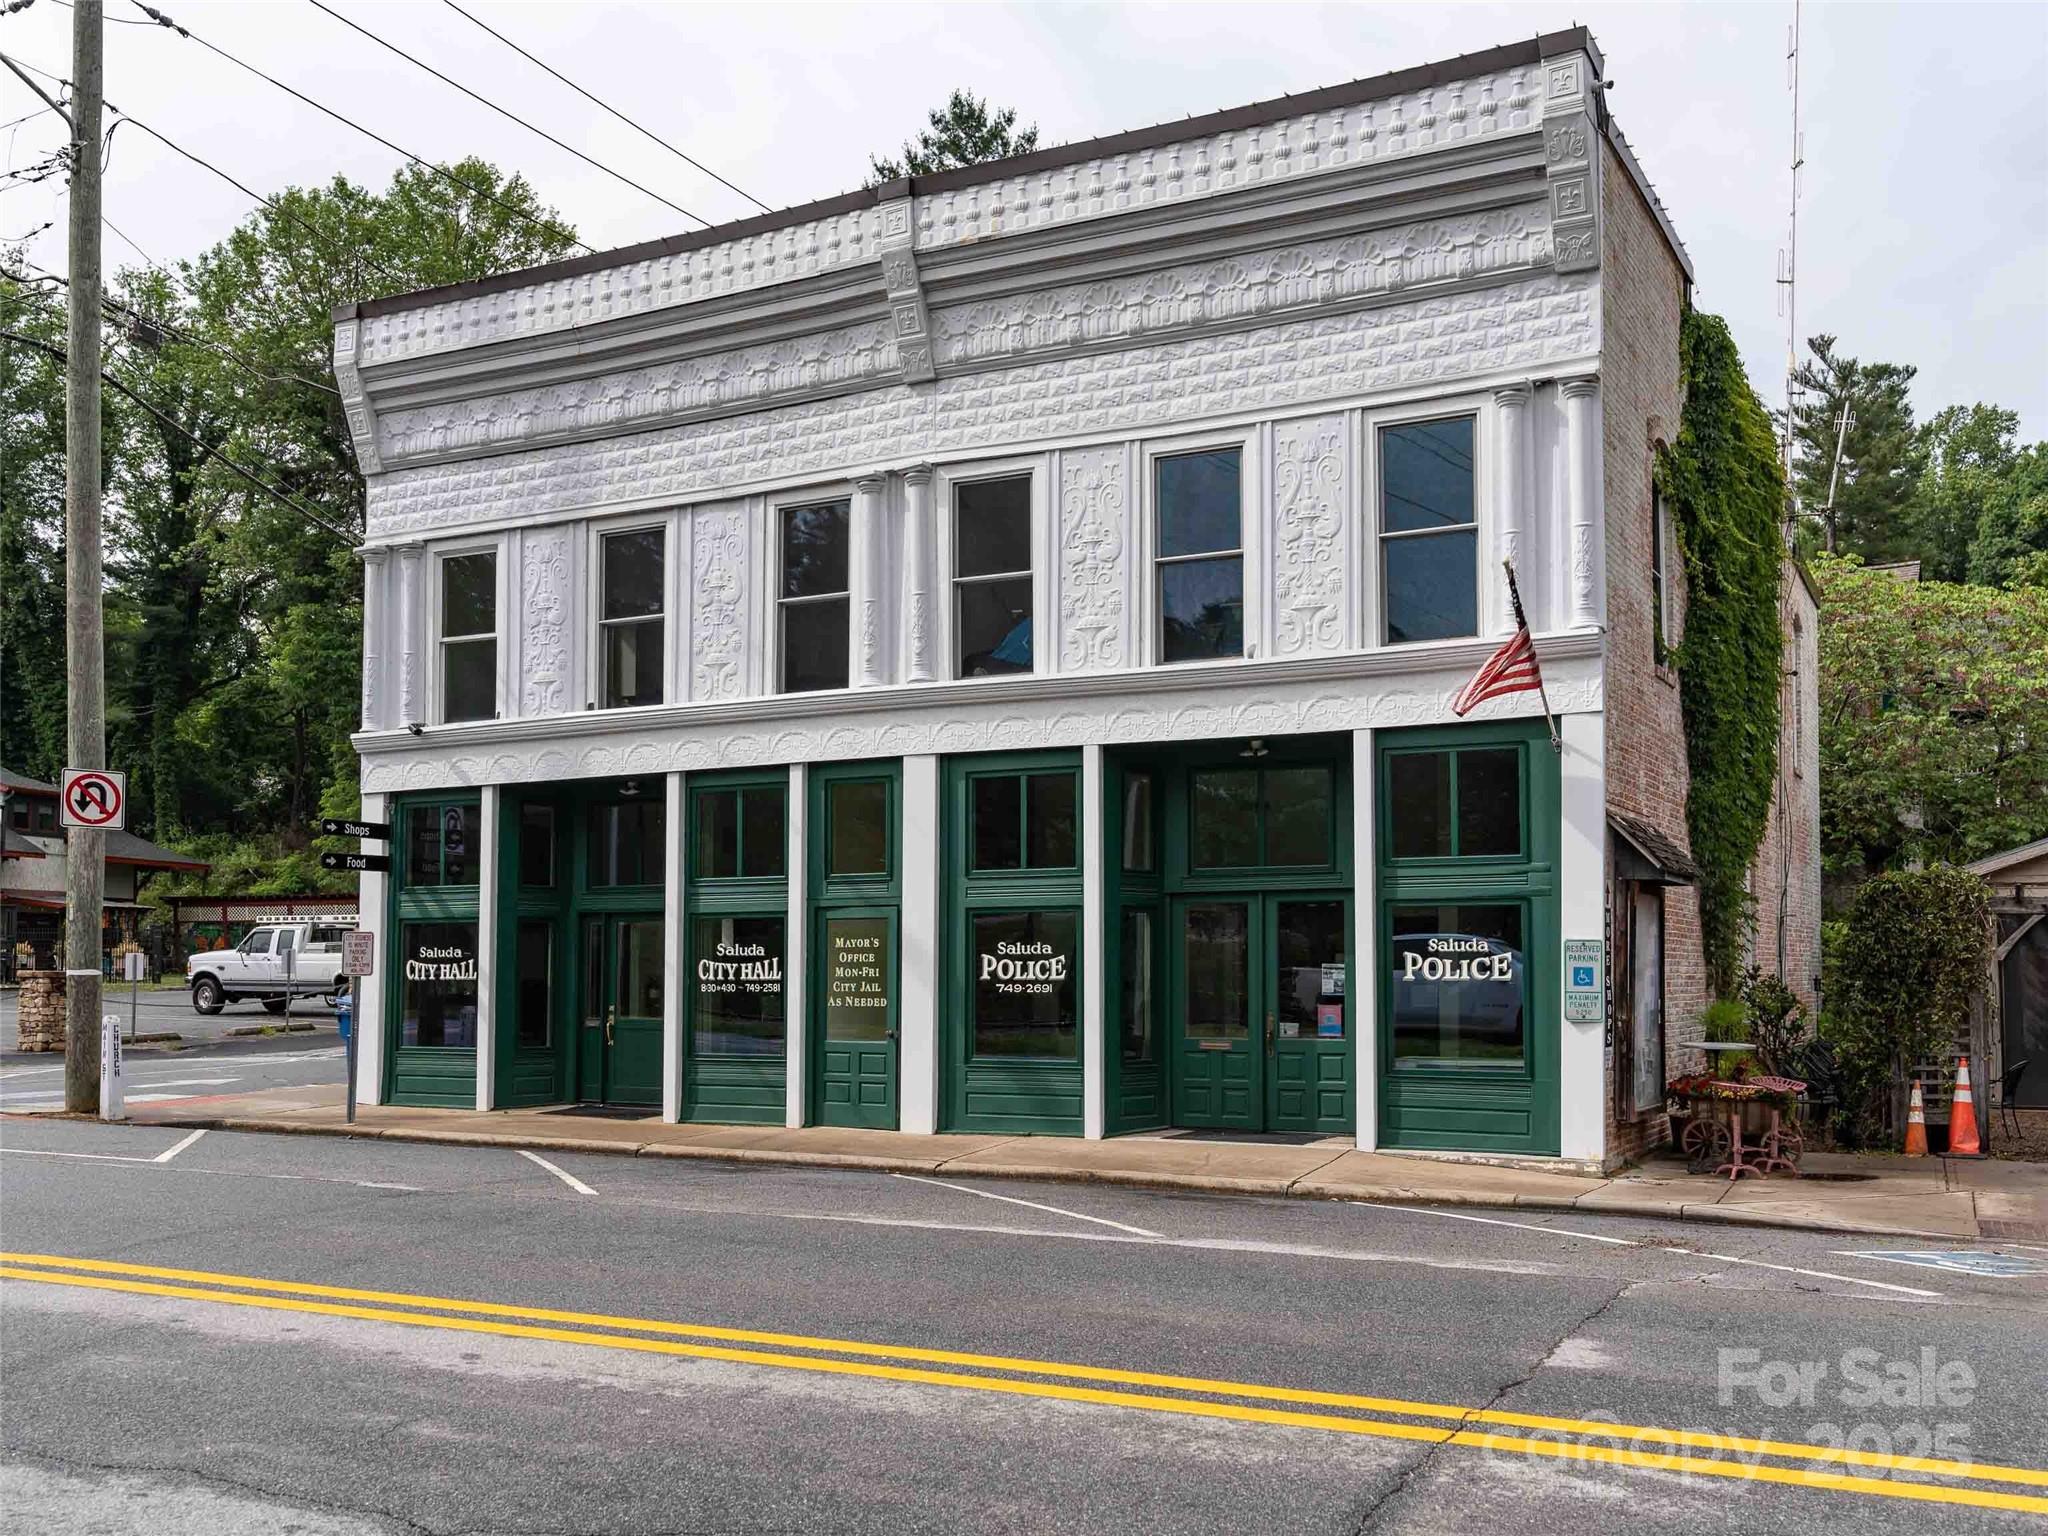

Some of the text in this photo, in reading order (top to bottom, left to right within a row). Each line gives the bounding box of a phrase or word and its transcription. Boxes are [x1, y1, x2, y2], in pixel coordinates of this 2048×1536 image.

[344, 823, 370, 837] Shops
[346, 856, 366, 869] Food
[835, 937, 880, 948] MAYOR'S
[997, 942, 1053, 955] Saluda
[1427, 938, 1489, 952] Saluda
[1566, 945, 1601, 953] RESERVED
[420, 946, 463, 958] Saluda
[716, 943, 765, 956] Saluda
[839, 952, 875, 963] OFFICE
[406, 959, 477, 981] CITY HALL
[699, 957, 782, 981] CITY HALL
[835, 967, 880, 977] MON-FRI
[979, 953, 1067, 981] POLICE
[1402, 952, 1513, 982] POLICE
[745, 983, 781, 993] 749-2581
[833, 981, 882, 993] CITY JAIL
[996, 983, 1053, 993] 749-2691
[828, 995, 888, 1007] AS NEEDED
[102, 1064, 106, 1081] ST
